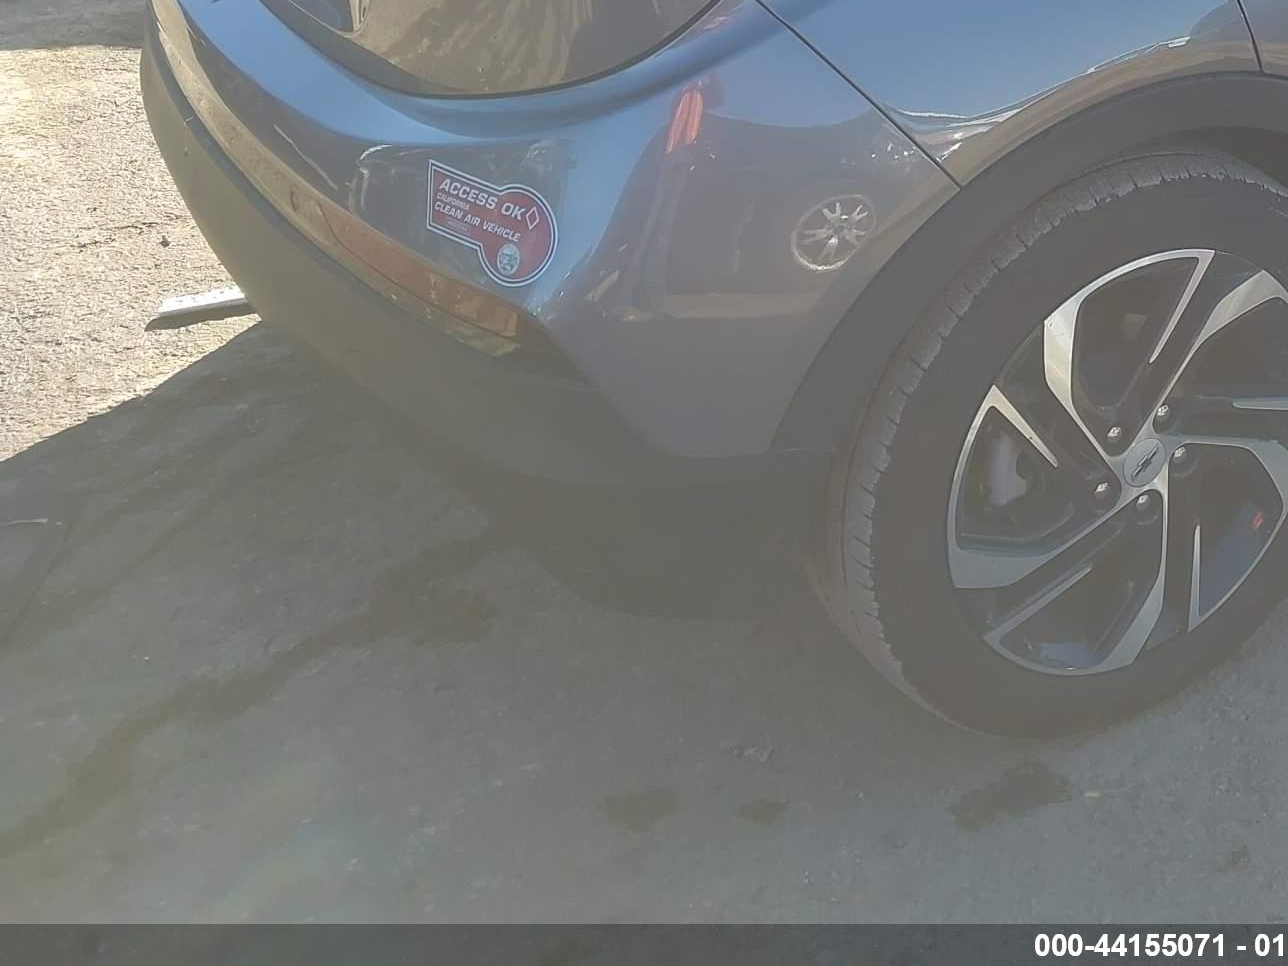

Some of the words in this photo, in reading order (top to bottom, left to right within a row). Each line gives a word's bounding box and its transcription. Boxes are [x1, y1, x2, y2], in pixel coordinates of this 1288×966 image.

[439, 178, 498, 210] ACCESS
[501, 202, 527, 220] OK
[434, 201, 464, 219] CLEAN
[464, 214, 481, 227] AIR
[482, 220, 521, 242] VEHICLE
